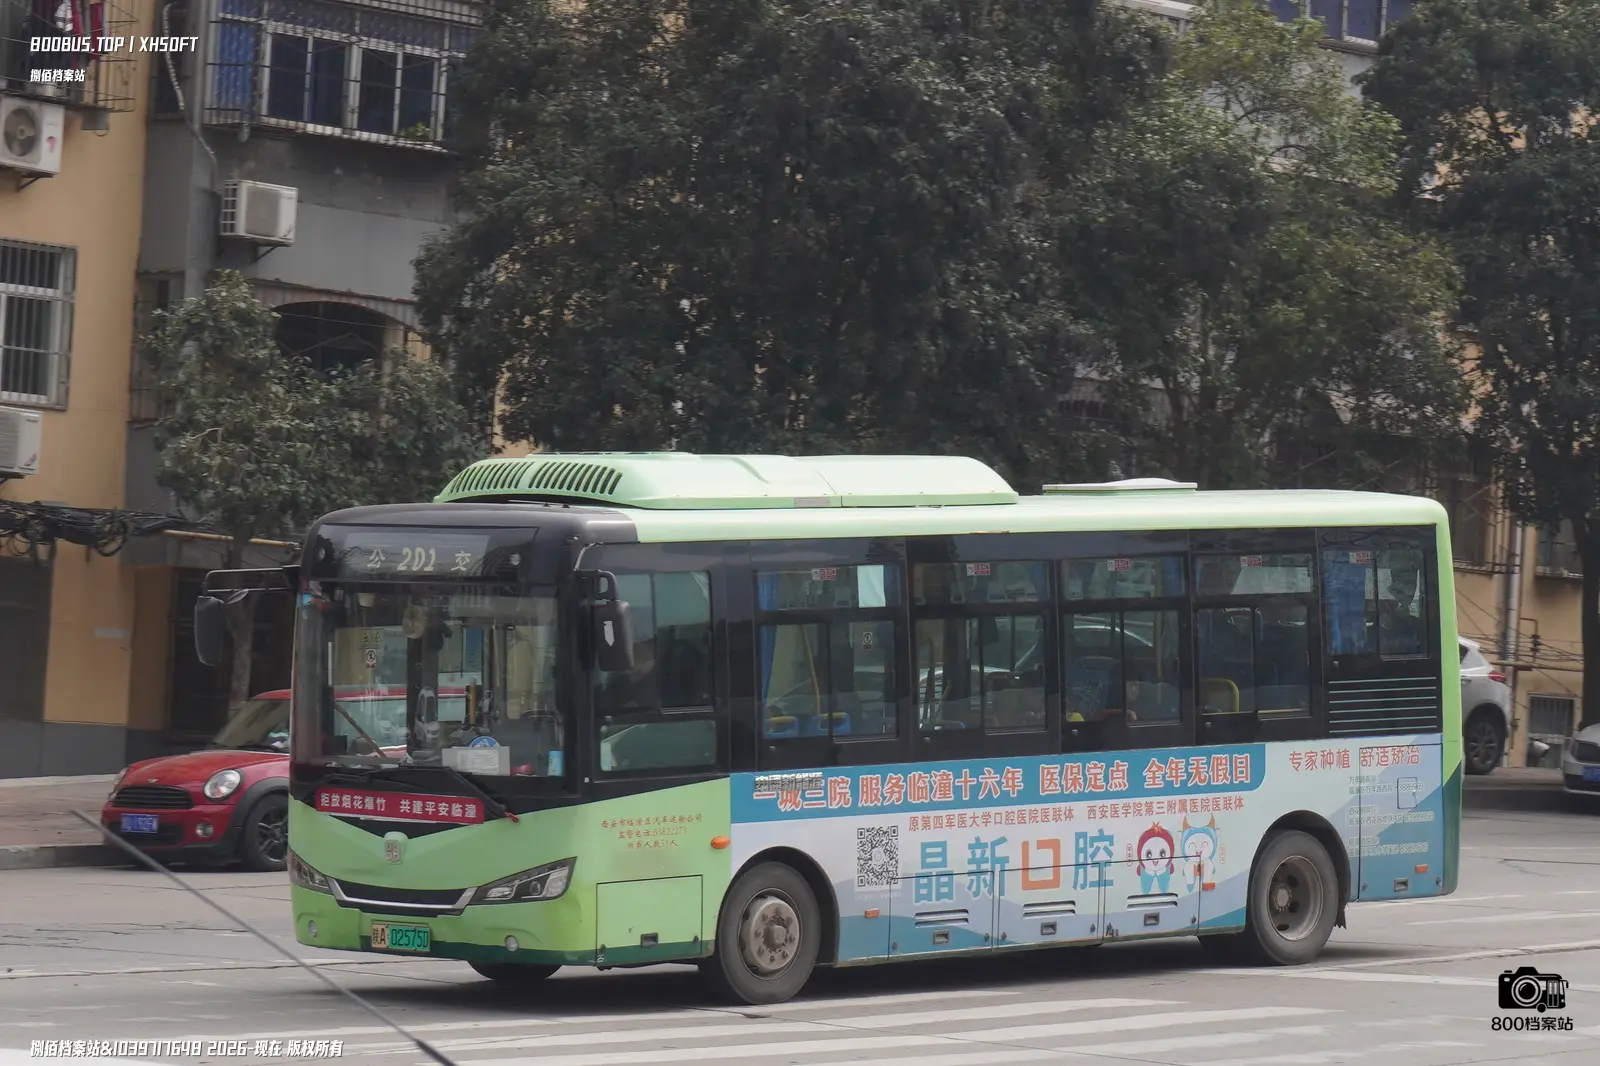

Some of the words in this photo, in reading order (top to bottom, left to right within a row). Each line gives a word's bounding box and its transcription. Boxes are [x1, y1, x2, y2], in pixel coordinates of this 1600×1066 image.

[367, 548, 386, 568] 公
[397, 547, 436, 571] 201
[450, 550, 472, 571] 交
[1289, 748, 1350, 772] 专家种植
[1360, 746, 1420, 768] 舒适矫治
[858, 766, 1023, 807] 服务临潼十六年
[1040, 760, 1128, 795] 医保定点
[1143, 754, 1250, 789] 全年无假日
[320, 792, 387, 812] 拒放烟花爆竹
[400, 799, 477, 818] 共建平安临潼
[909, 807, 1074, 832] 原第四军医大学口腔医院医联体
[1087, 796, 1244, 820] 西安医学院第三附属医院医联体
[913, 828, 1114, 904] 晶新口腔
